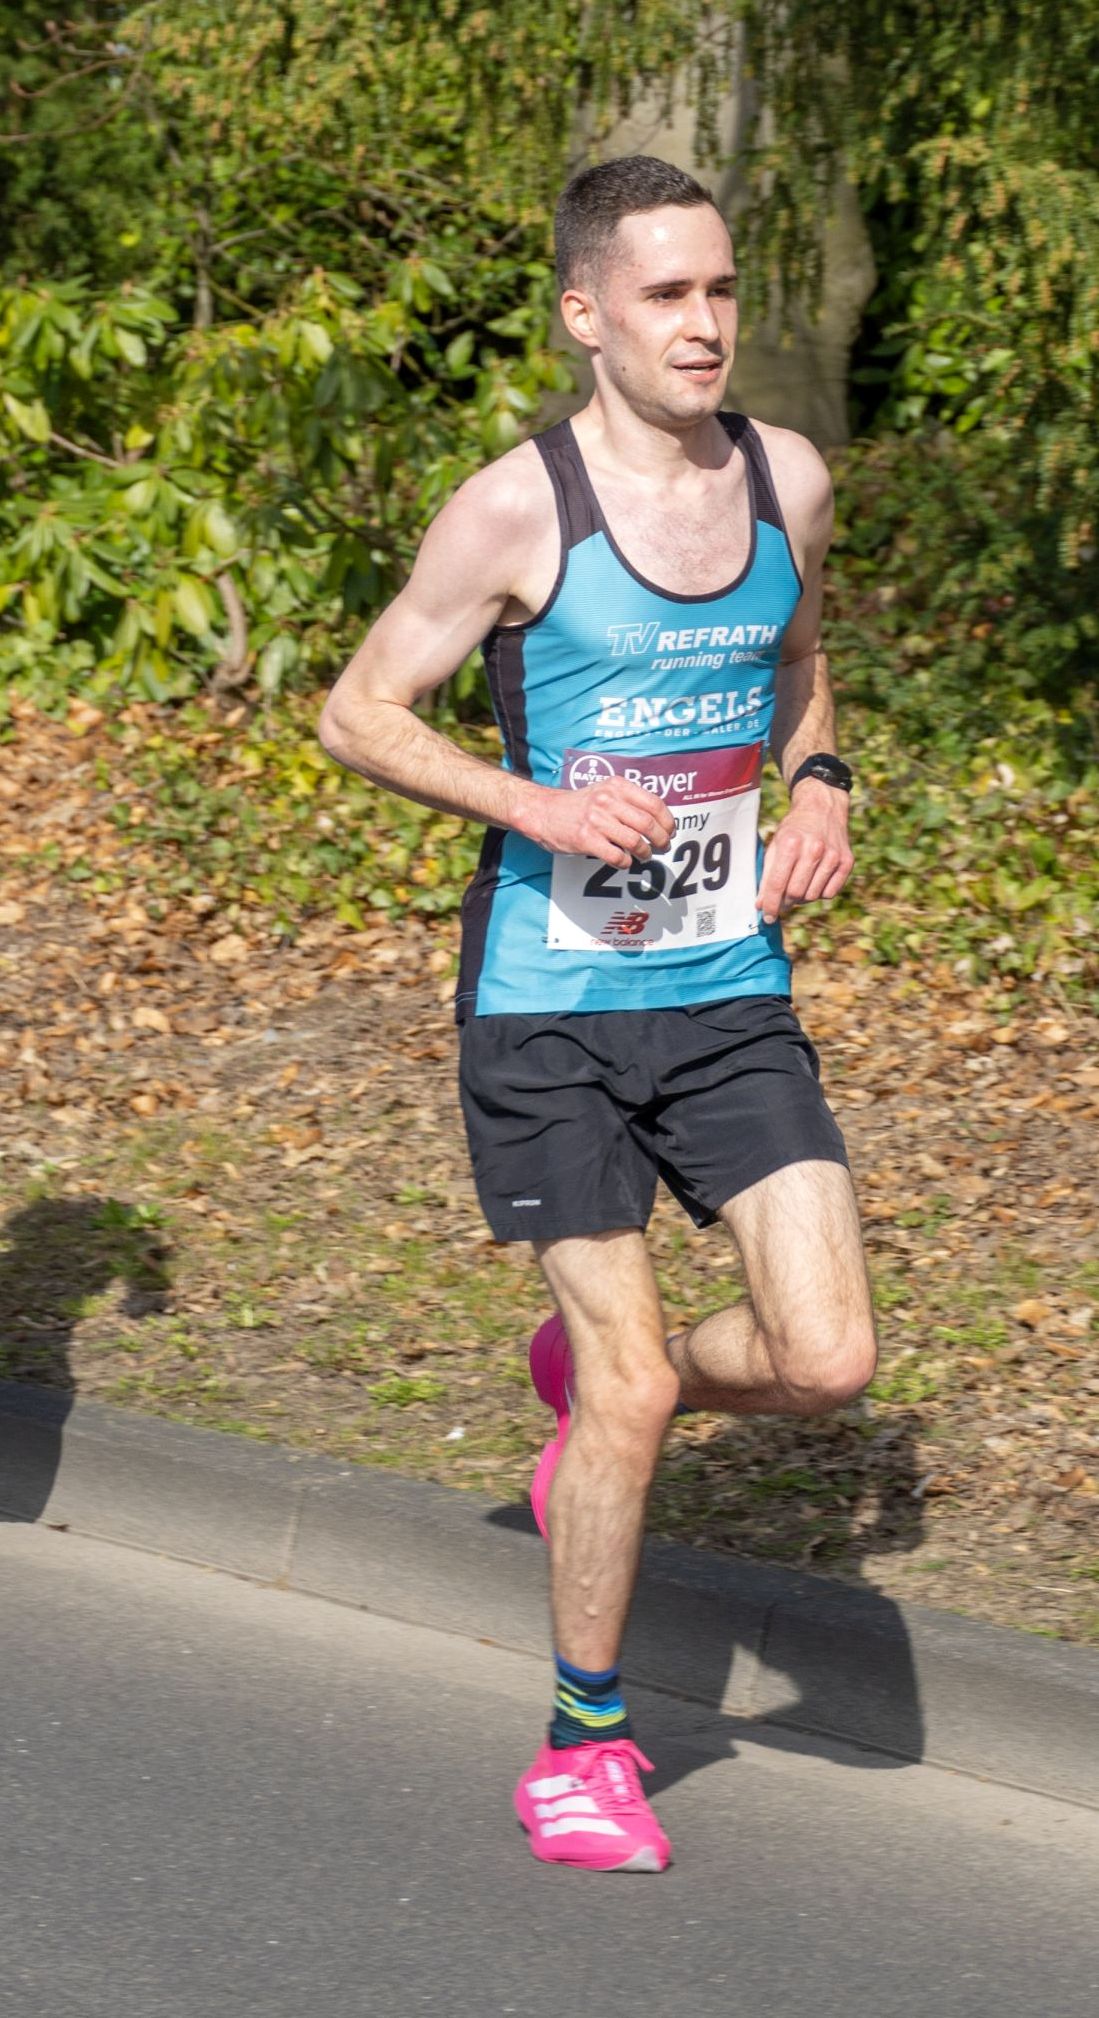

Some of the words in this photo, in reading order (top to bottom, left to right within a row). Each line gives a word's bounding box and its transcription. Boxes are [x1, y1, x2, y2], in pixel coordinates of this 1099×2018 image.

[607, 621, 661, 656] TV
[656, 625, 777, 652] REFRATH
[651, 652, 725, 670] running
[596, 686, 763, 727] ENGELS
[624, 769, 697, 799] Bayer
[583, 833, 731, 901] 2529
